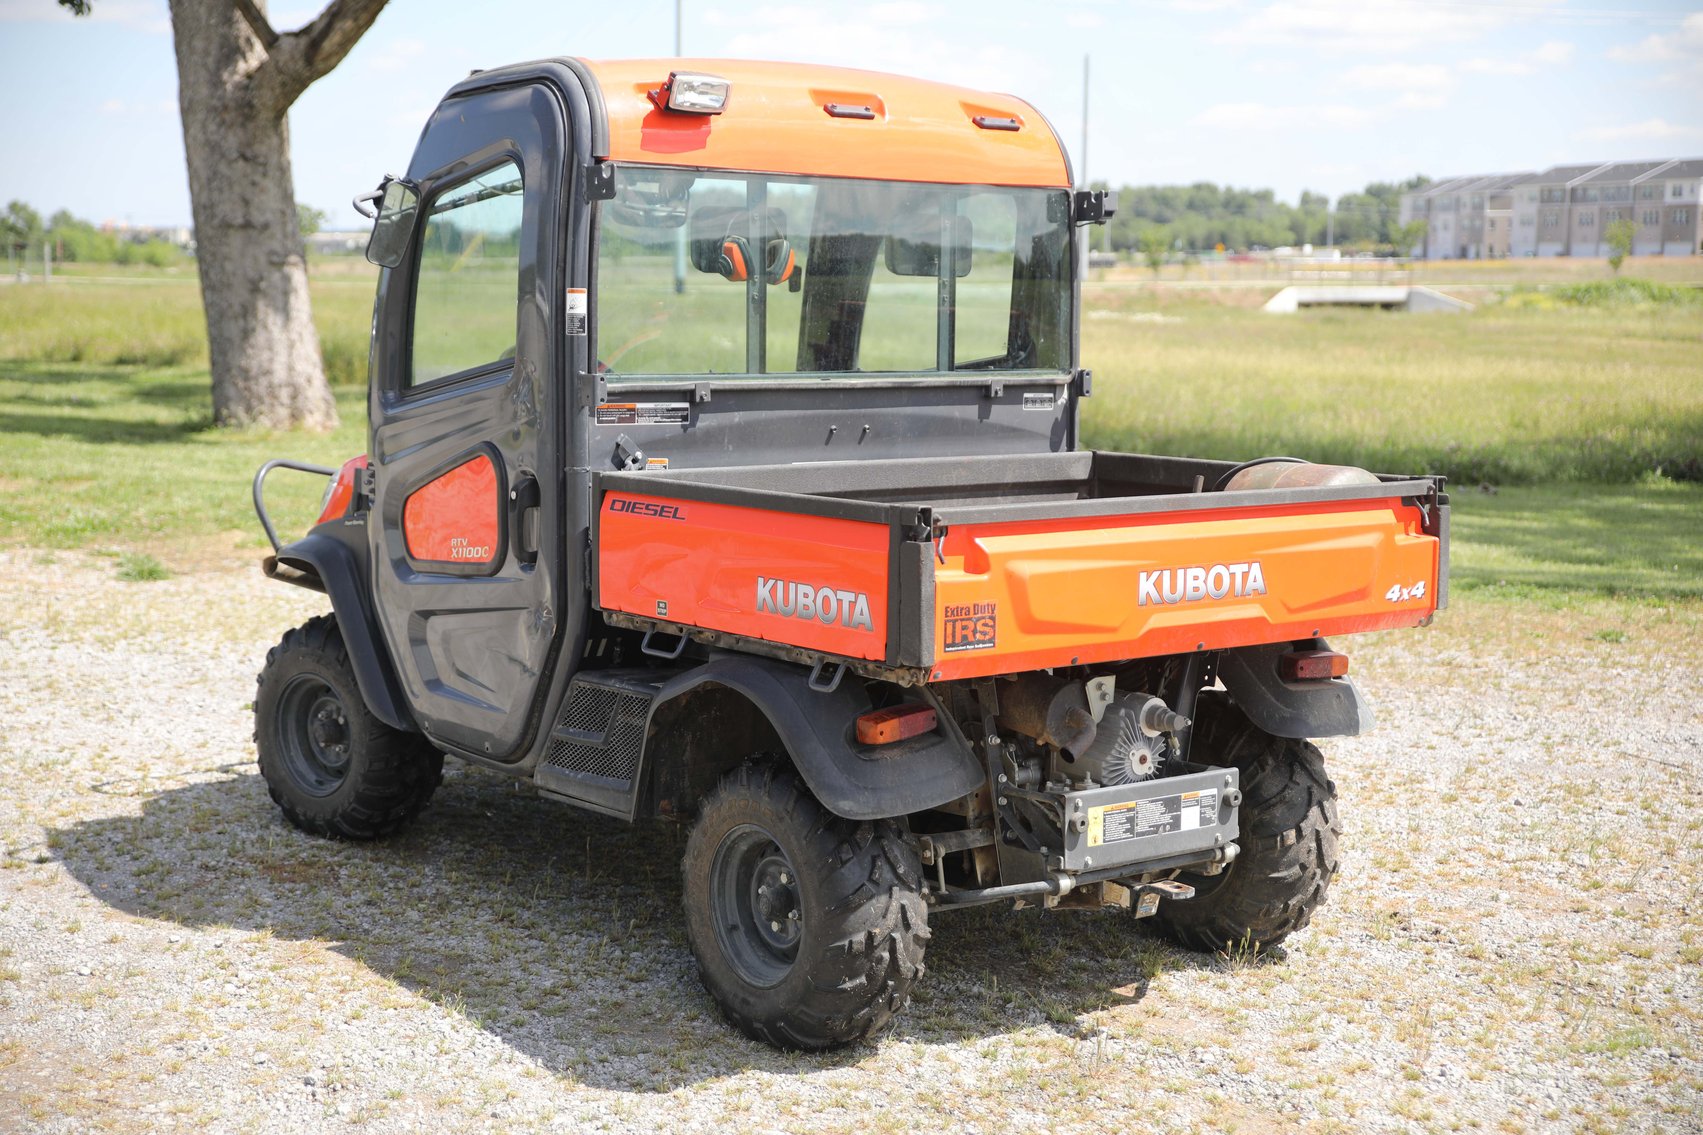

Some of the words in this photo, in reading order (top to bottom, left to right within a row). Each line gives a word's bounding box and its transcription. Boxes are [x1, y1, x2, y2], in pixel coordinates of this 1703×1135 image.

[609, 499, 686, 520] DIESEL
[451, 538, 468, 546] RTV
[451, 546, 489, 558] X1100C
[1138, 561, 1267, 606] KUBOTA
[1385, 580, 1426, 603] 4x4
[756, 576, 874, 632] KUBOTA
[945, 605, 970, 618] Extra
[973, 603, 996, 615] Duty
[946, 618, 994, 644] IRS
